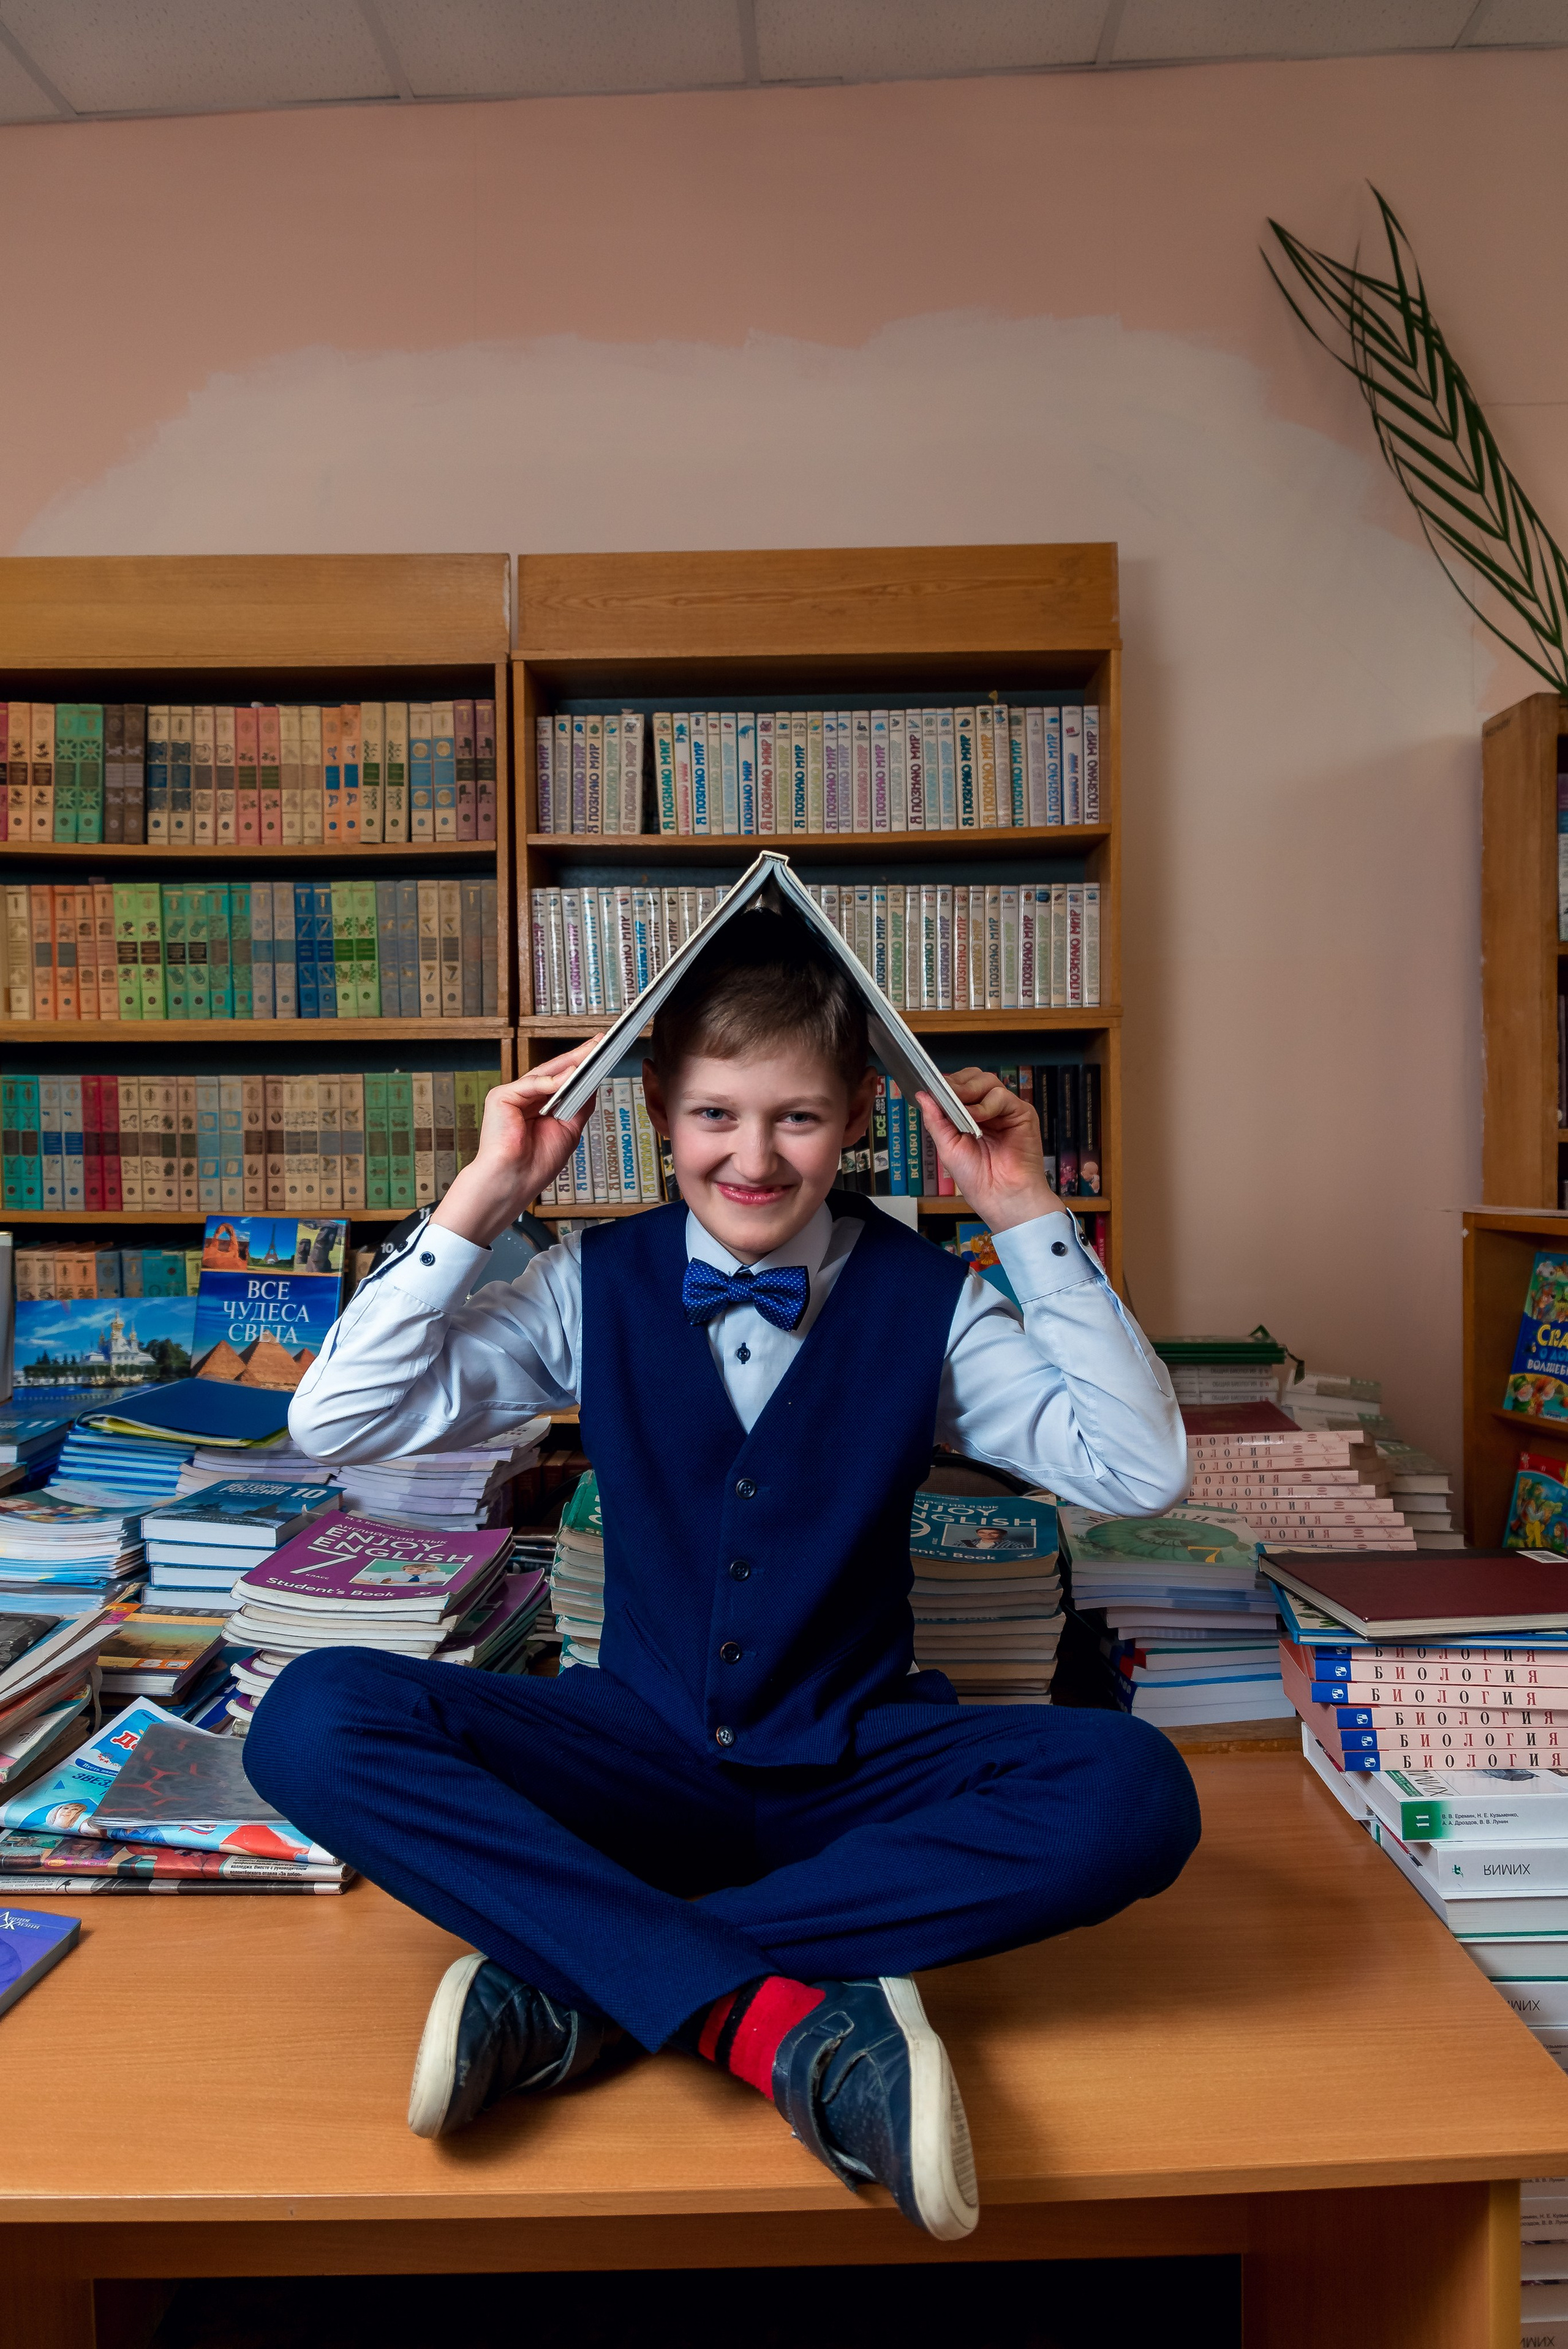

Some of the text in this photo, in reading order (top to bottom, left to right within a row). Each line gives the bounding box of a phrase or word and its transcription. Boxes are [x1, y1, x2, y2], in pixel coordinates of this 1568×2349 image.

[587, 743, 600, 833] Я ПОЗНАЮ МИР
[659, 738, 675, 830] Я ПОЗНАЮ МИР
[693, 741, 707, 826] Я ПОЗНАЮ МИР
[760, 739, 774, 831] Я ПОЗНАЮ МИР
[794, 744, 806, 829] Я ПОЗНАЮ МИР
[826, 746, 837, 830] Я ПОЗНАЮ МИР
[924, 916, 935, 999] Я ПОЗНАЮ МИР
[940, 915, 951, 999] Я ПОЗНАЮ МИР
[954, 916, 967, 1003] Я ПОЗНАЮ МИР
[603, 1109, 620, 1191] Я ПОЗНАЮ МИР
[619, 1107, 636, 1190] Я ПОЗНАЮ МИР
[636, 1103, 656, 1193] Я ПОЗНАЮ МИР
[891, 1105, 902, 1181] ВСЁ ОБО ВСЕХ
[910, 1133, 918, 1156] ОБО
[908, 1158, 919, 1179] ВСЁ
[925, 1159, 935, 1180] ВСЁ
[380, 1243, 394, 1254] 10
[247, 1280, 291, 1300] ВСЕ
[223, 1301, 310, 1323] ЧУДЕСА
[228, 1323, 299, 1344] СВЕТА
[1550, 1350, 1568, 1361] ДО
[218, 1486, 328, 1499] РОССИИ 10
[227, 1483, 293, 1491] ИСТОРИЯ
[914, 1499, 967, 1509] ИЙСКИЙ
[334, 1523, 415, 1542] АНГЛИЙСКИЙ
[364, 1520, 415, 1534] Биболетова
[312, 1535, 475, 1564] ENGLISH
[324, 1526, 445, 1552] ENJOY
[290, 1545, 358, 1575] 7
[952, 1552, 997, 1560] Book
[1187, 1545, 1221, 1563] 7
[265, 1576, 397, 1598] Student's Book
[138, 1659, 164, 1668] 8
[1374, 1647, 1536, 1663] БИОЛОГИЯ
[1374, 1665, 1539, 1684] БИОЛОГИЯ
[1370, 1687, 1537, 1706] БИОЛОГИЯ
[1395, 1710, 1555, 1727] БИОЛОГИЯ
[1400, 1730, 1559, 1749] БИОЛОГИЯ
[82, 1763, 100, 1772] Пусть
[1402, 1752, 1562, 1769] БИОЛОГИЯ
[72, 1772, 112, 1787] ЗВЕЗ
[1415, 1814, 1430, 1828] 11
[1483, 1863, 1531, 1876] ХИМИЯ
